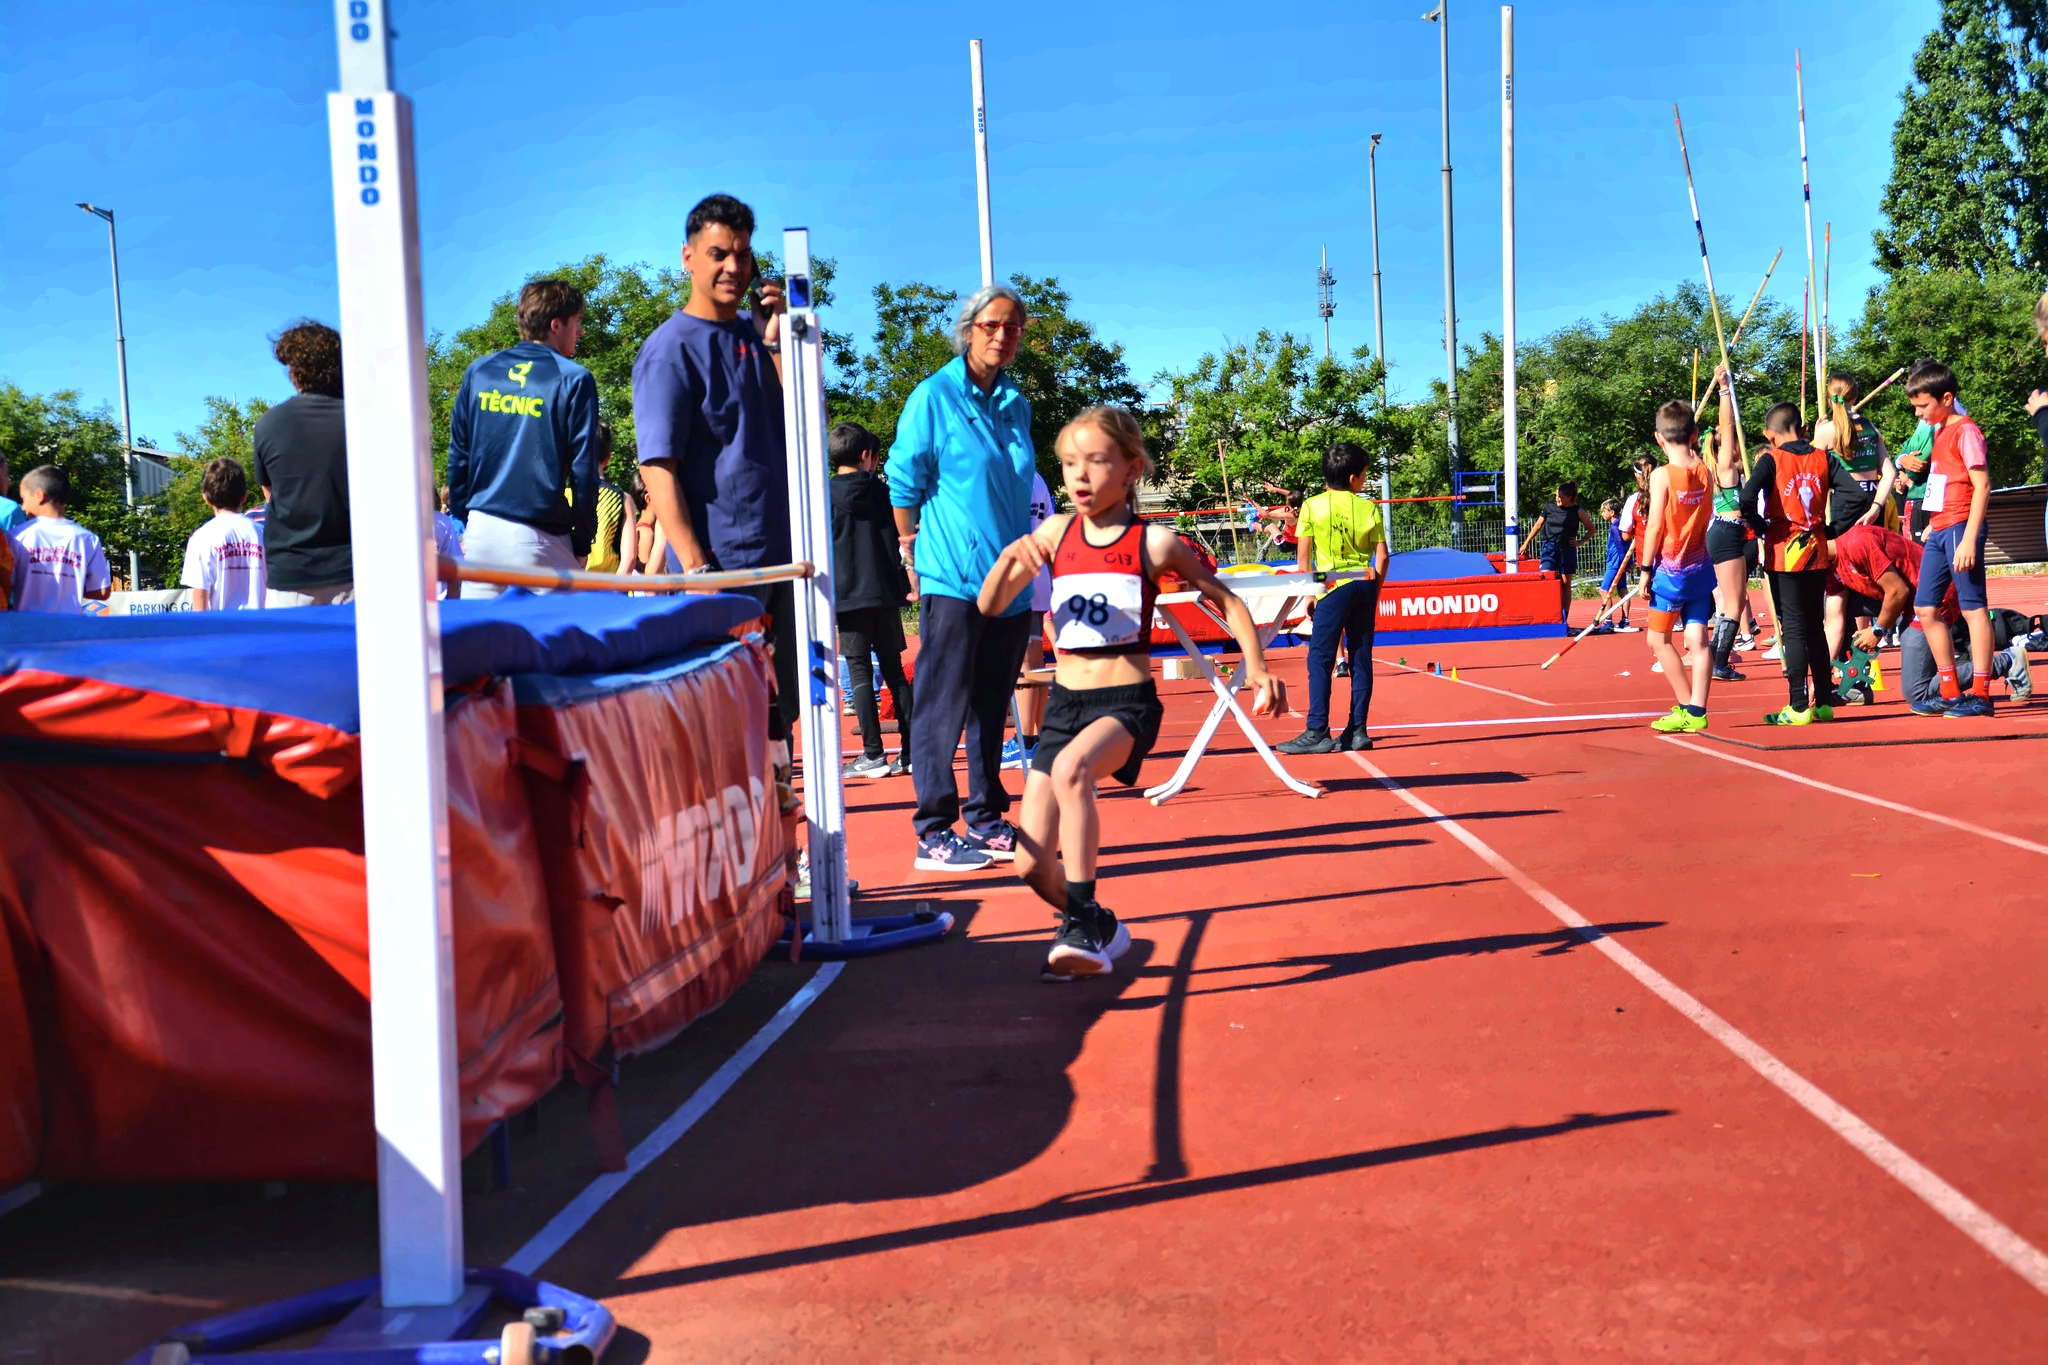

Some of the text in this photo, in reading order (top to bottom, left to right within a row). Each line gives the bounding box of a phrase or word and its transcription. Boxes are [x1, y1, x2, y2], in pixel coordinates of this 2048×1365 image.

[355, 98, 380, 206] MONDO
[130, 602, 178, 616] PARKING
[1068, 593, 1108, 626] 98
[1401, 594, 1498, 616] MONDO
